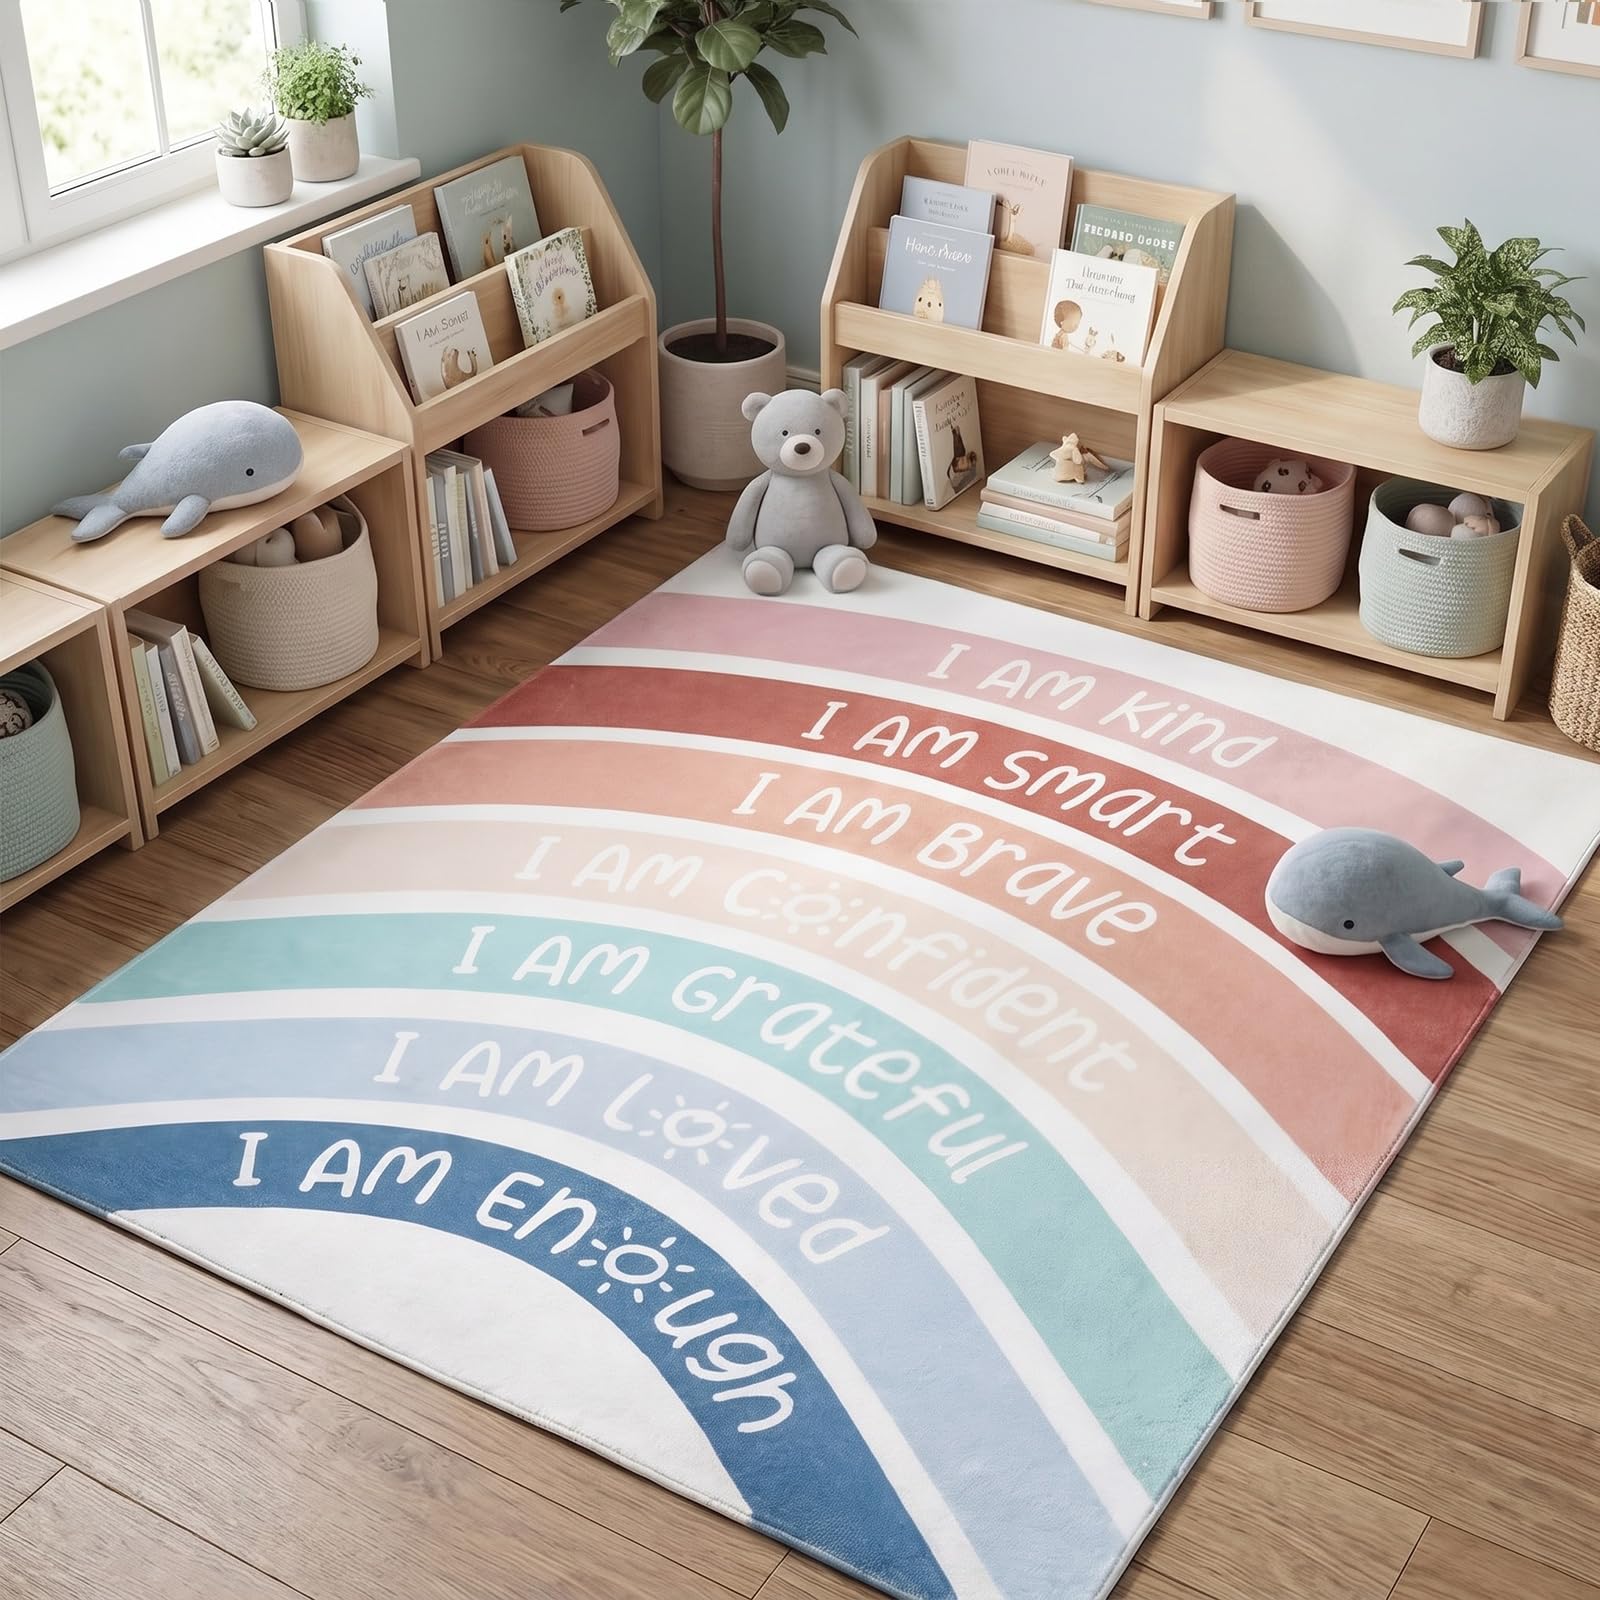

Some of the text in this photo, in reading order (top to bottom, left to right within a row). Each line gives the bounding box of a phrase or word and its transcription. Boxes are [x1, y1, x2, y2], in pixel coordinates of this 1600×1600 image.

[801, 701, 1237, 866] I AM Smart
[928, 644, 1277, 767] I AM Kind
[515, 837, 1137, 1092] I AM Confident
[733, 774, 1158, 946] I AM Brave
[373, 1032, 889, 1265] I AM Loved
[453, 926, 1029, 1185] I AM Grateful
[233, 1132, 797, 1434] I AM Enough
